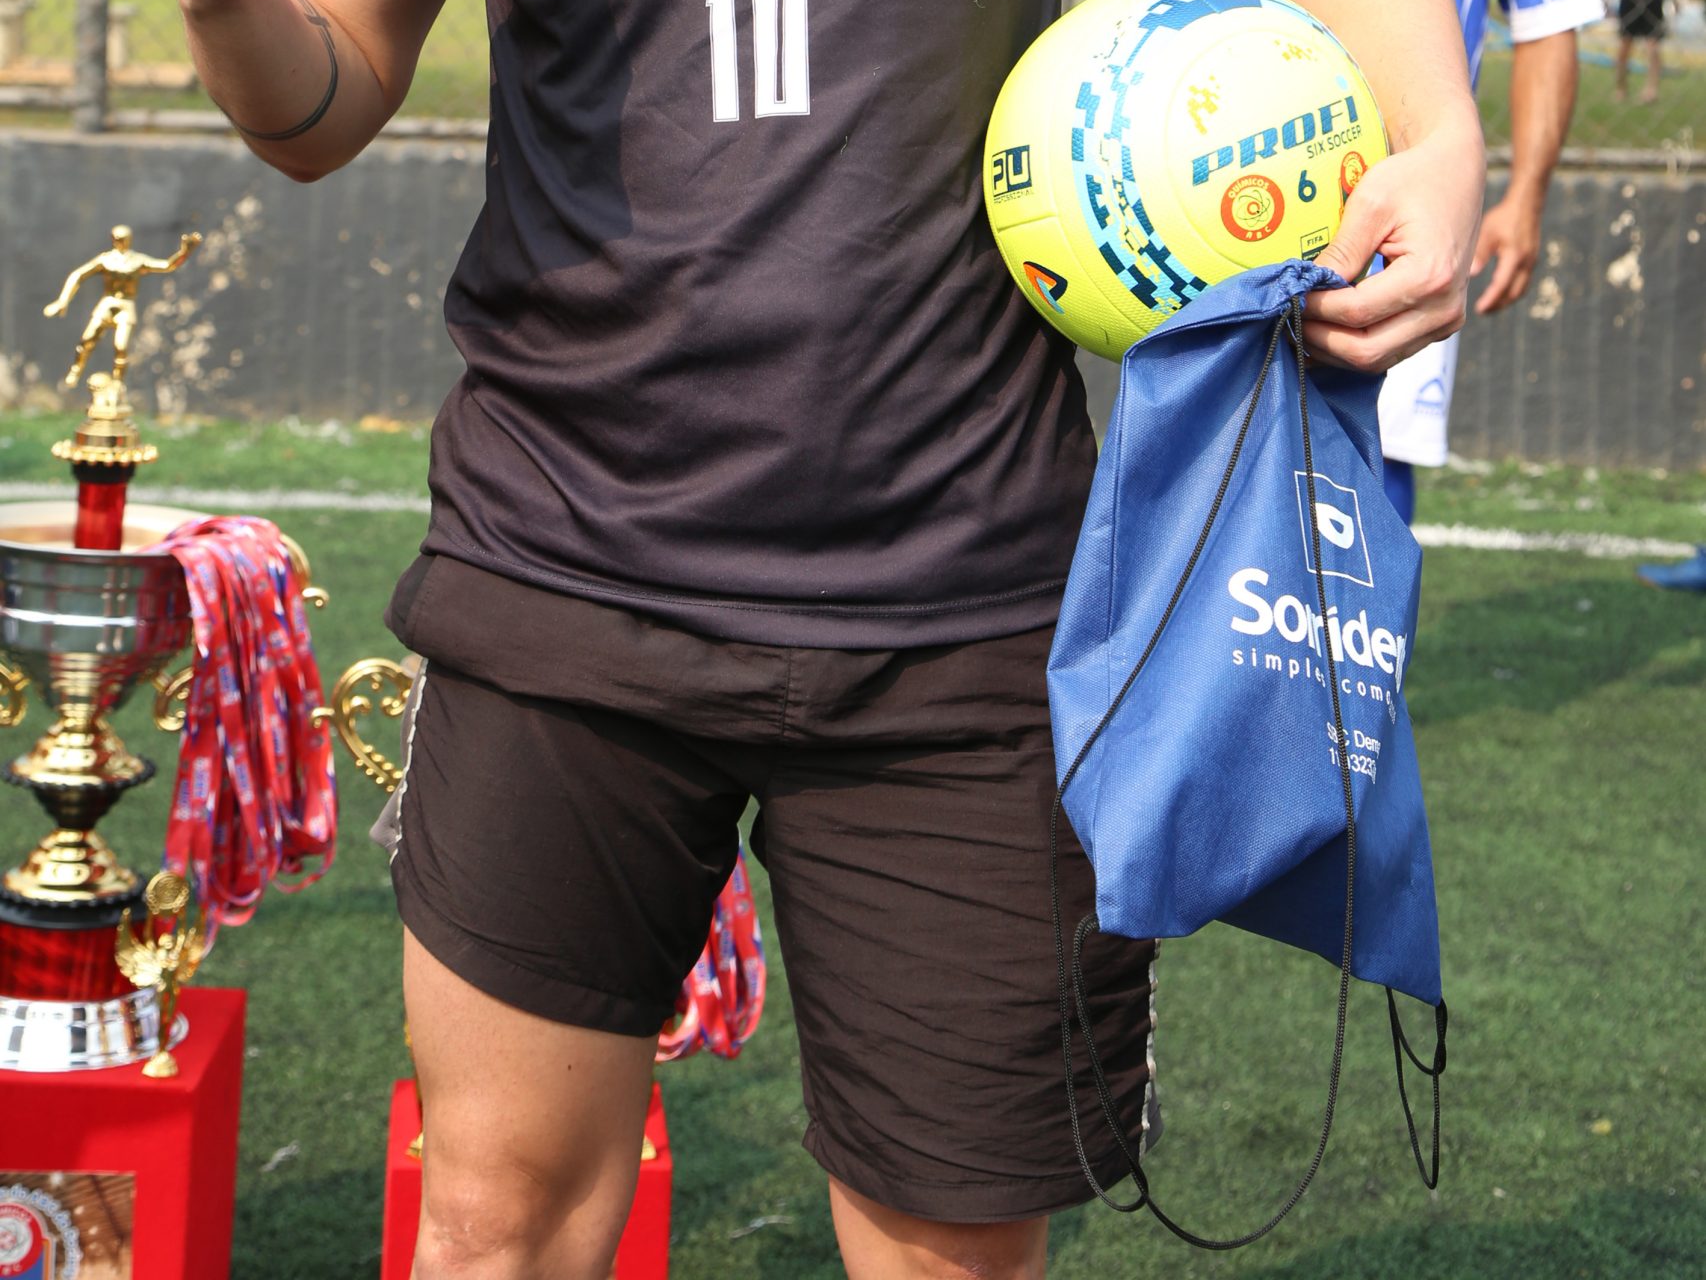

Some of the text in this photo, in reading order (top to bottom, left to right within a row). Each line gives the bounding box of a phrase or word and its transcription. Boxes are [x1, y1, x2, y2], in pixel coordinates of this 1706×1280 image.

[1191, 95, 1359, 186] PROFI
[1306, 124, 1362, 159] SIX SOCCER
[1228, 177, 1270, 199] QUÍMICOS
[1298, 170, 1317, 203] 6
[1306, 234, 1324, 247] FIFA
